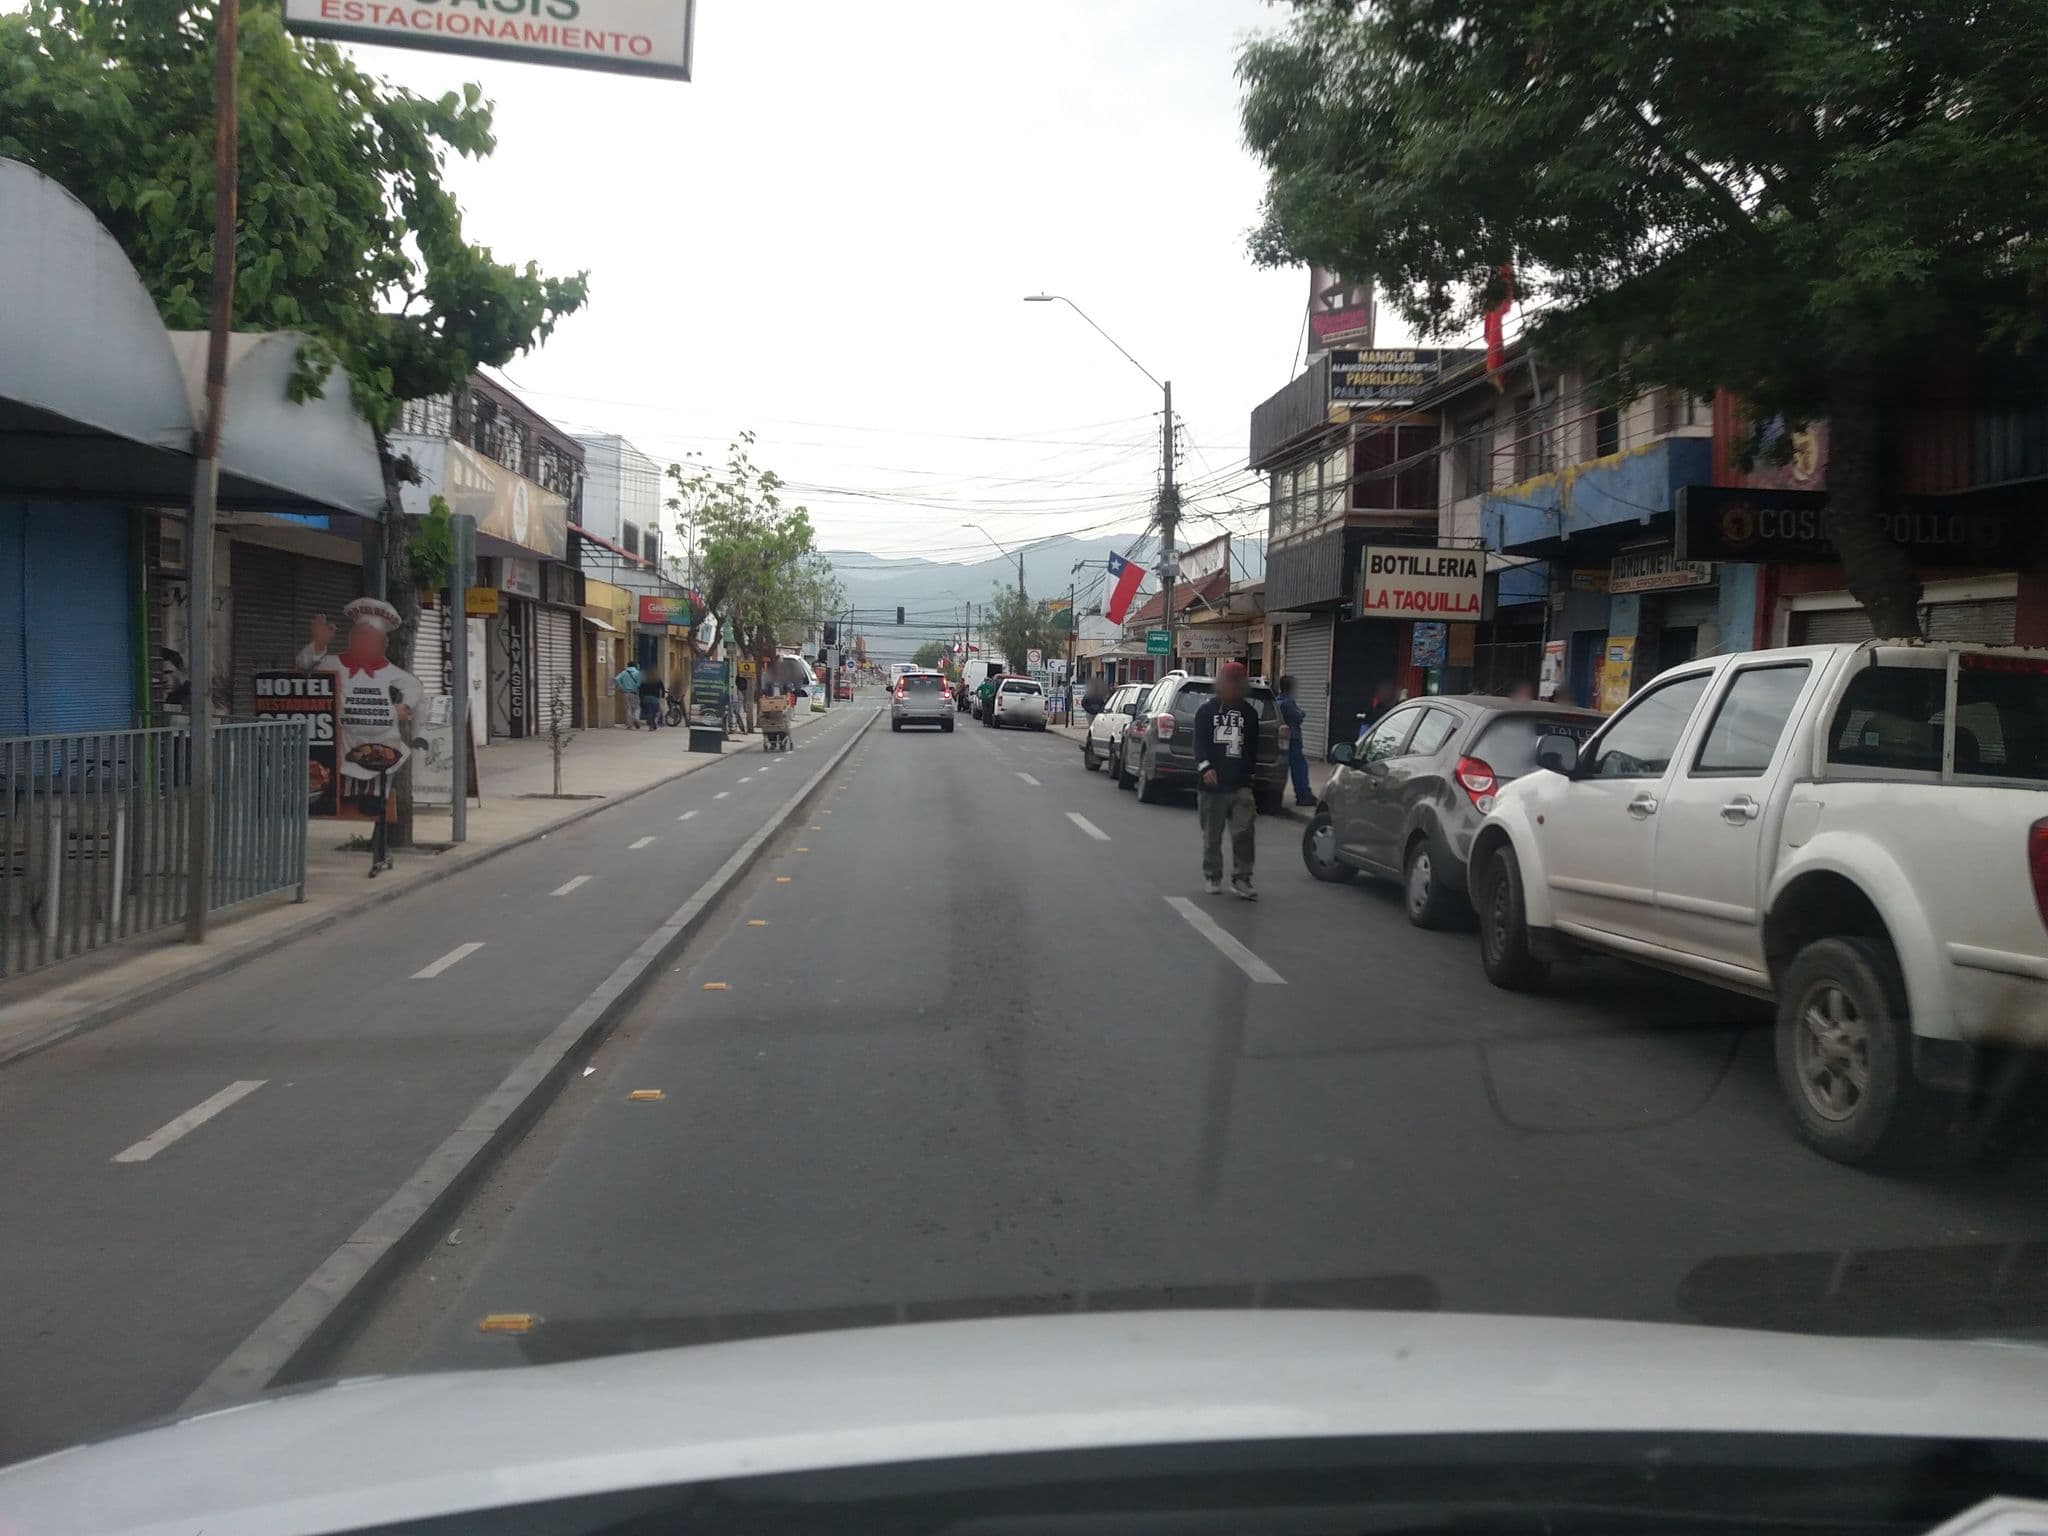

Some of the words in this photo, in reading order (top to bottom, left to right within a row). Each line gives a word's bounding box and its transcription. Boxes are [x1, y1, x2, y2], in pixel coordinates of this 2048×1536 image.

[320, 0, 652, 57] ESTACIONAMIENTO
[1370, 555, 1478, 578] BOTILLERIA
[1363, 588, 1389, 609] LA
[1392, 590, 1480, 613] TAQUILLA
[511, 625, 522, 717] LAVASECO
[256, 678, 334, 696] HOTEL
[345, 696, 390, 706] PESCADOS
[343, 707, 390, 717] MARISCOS
[1213, 714, 1245, 728] EVER
[341, 717, 393, 726] PARRILLADAS
